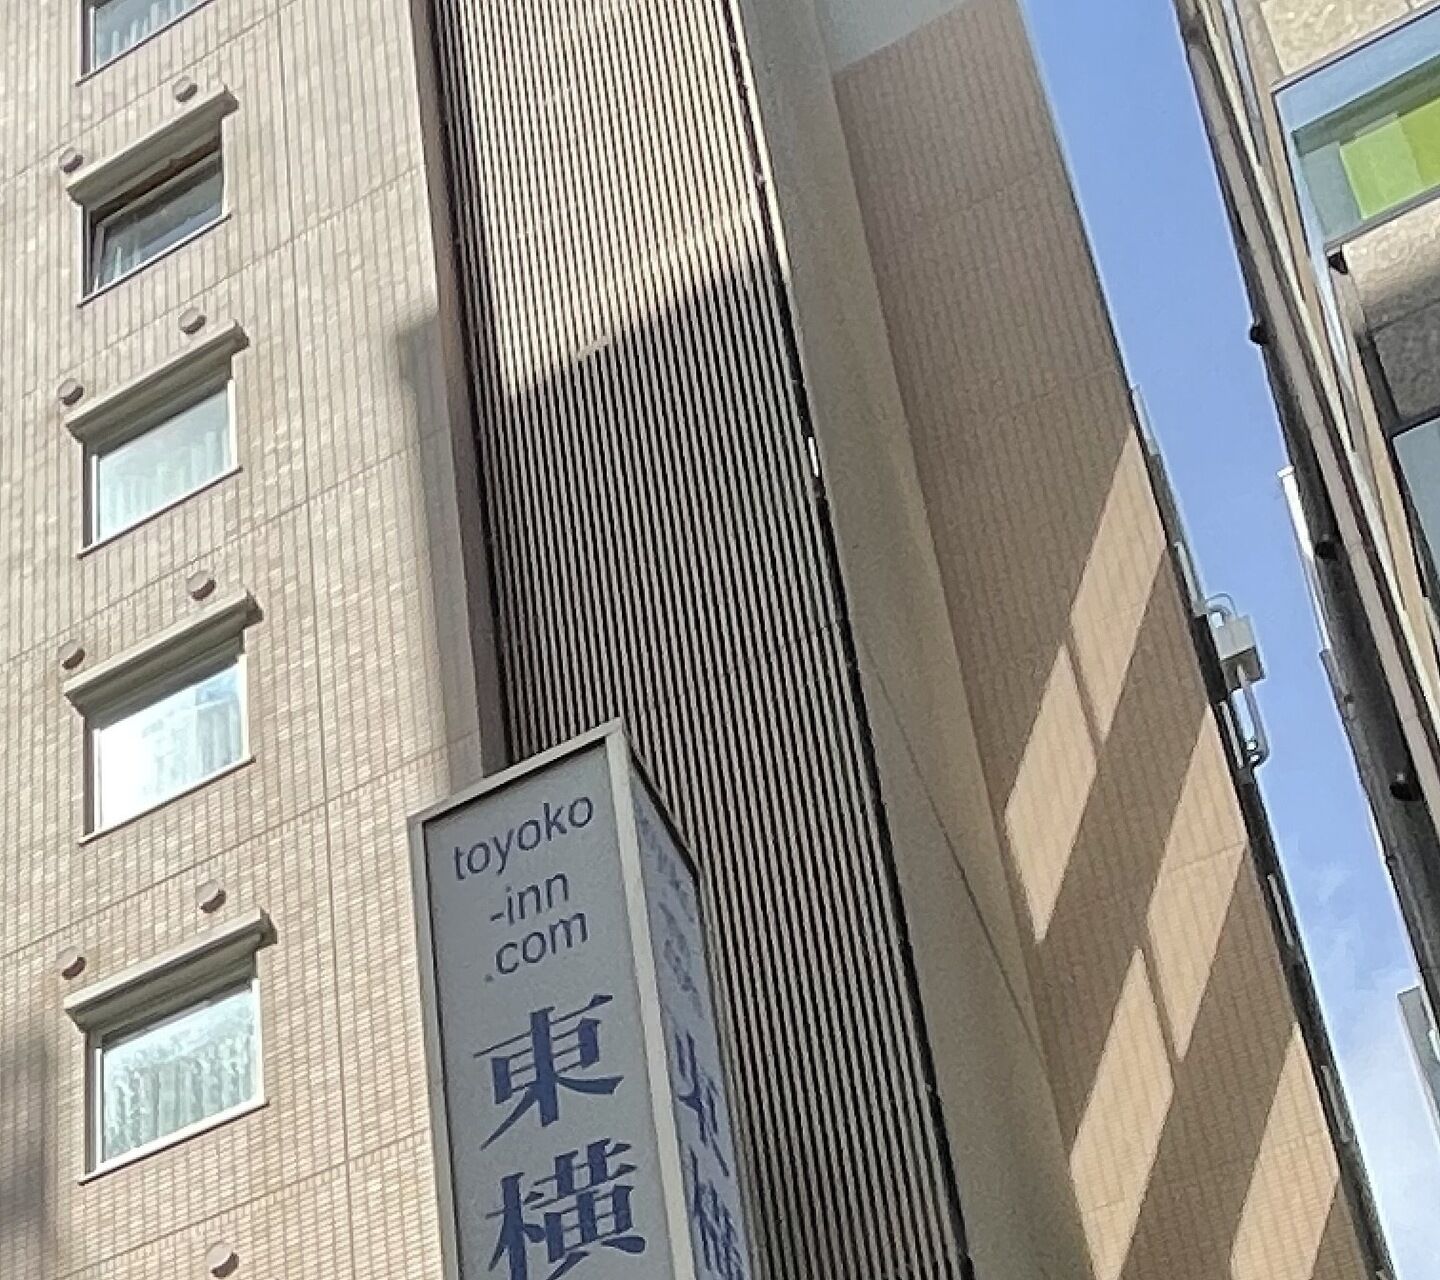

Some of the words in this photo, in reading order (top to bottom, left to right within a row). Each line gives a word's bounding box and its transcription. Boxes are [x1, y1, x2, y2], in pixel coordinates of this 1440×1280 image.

[452, 794, 595, 881] toyoko
[490, 872, 570, 926] -inn
[483, 907, 588, 983] .com
